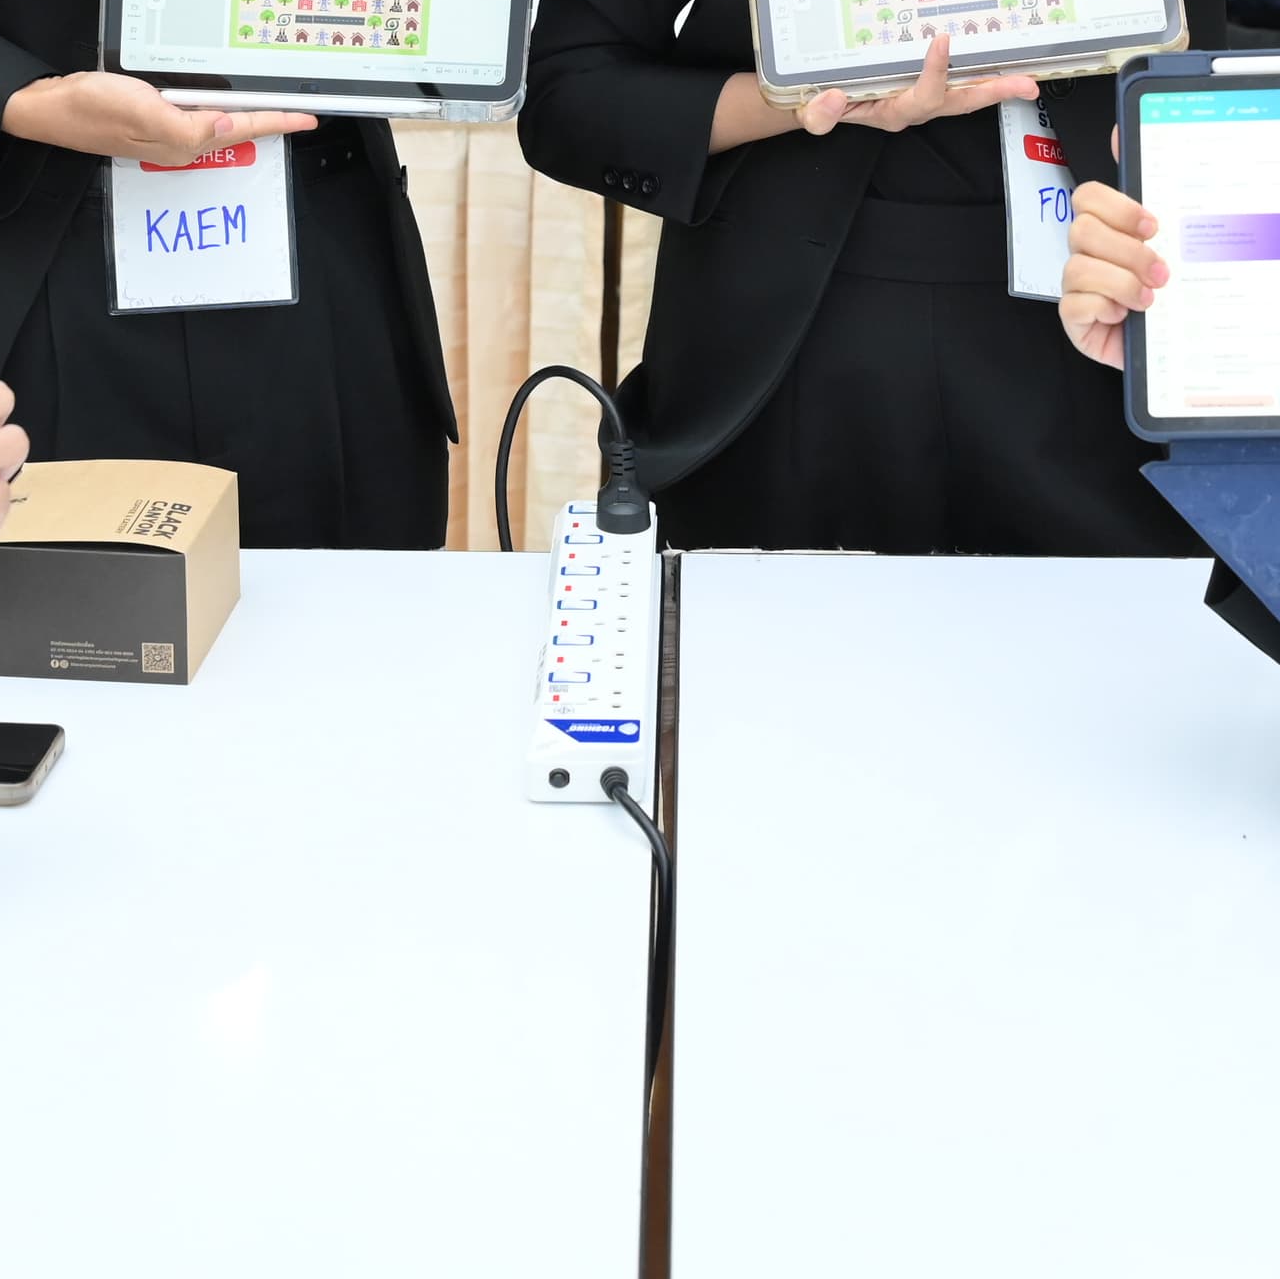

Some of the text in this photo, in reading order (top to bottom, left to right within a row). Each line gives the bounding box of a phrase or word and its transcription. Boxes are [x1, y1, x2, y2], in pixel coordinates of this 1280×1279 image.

[1035, 142, 1066, 160] TEAC
[145, 204, 246, 253] KAEM
[133, 500, 169, 536] CANYON
[152, 503, 193, 540] BLACK
